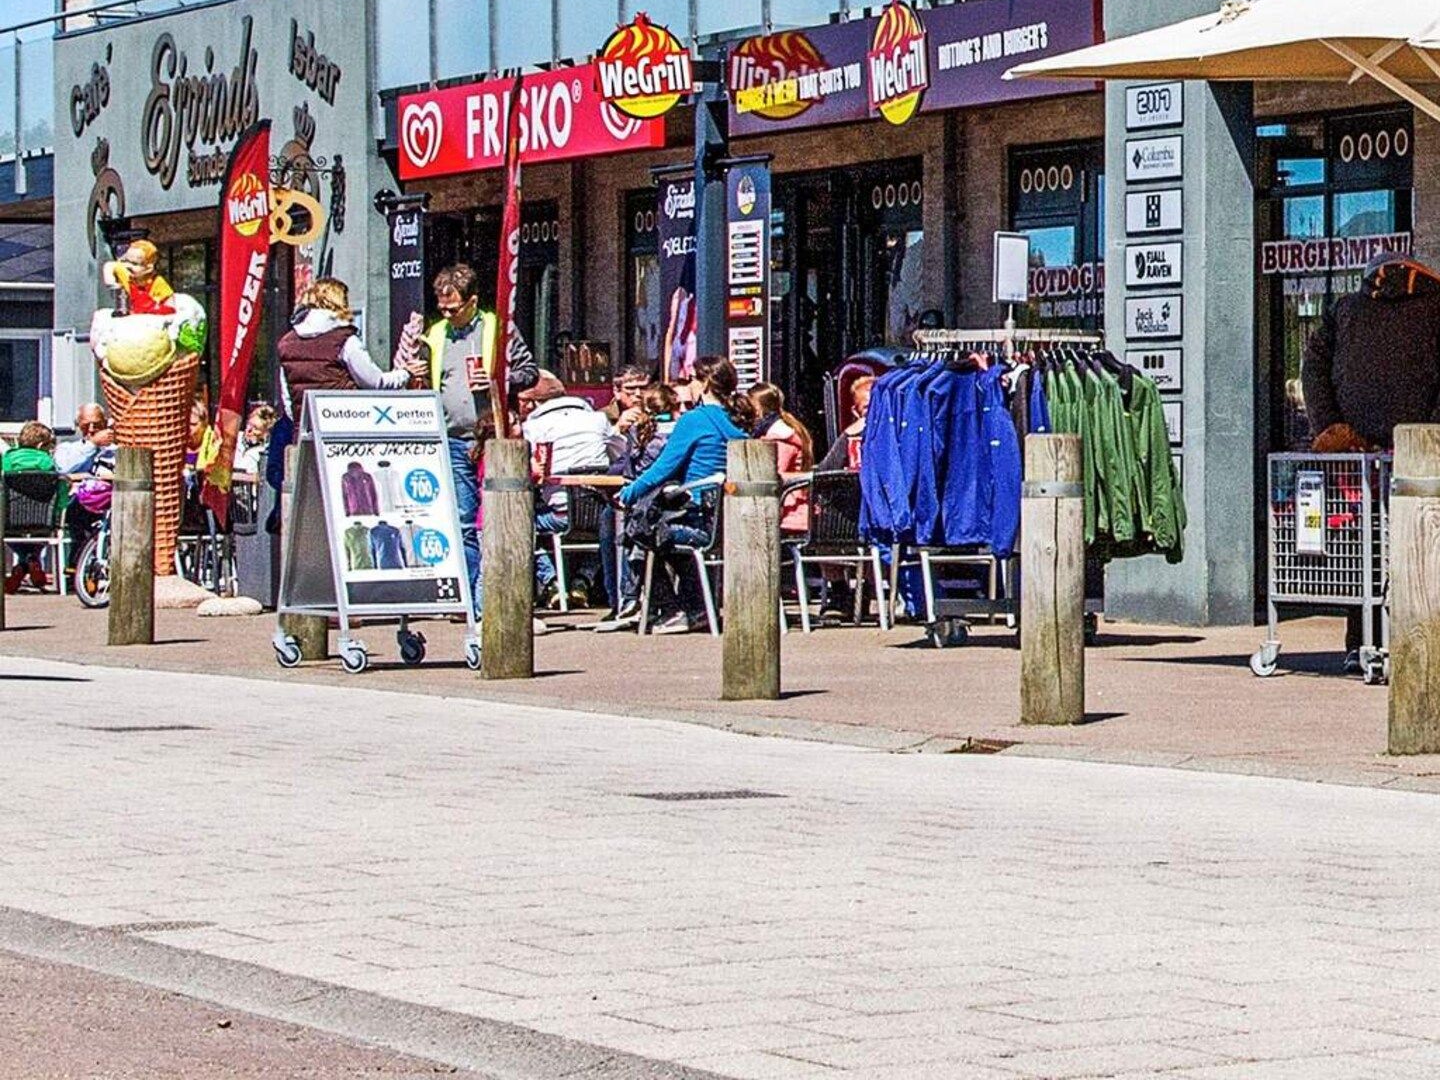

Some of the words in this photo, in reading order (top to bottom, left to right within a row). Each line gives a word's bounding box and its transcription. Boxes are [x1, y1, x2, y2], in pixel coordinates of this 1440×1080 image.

[982, 31, 1002, 61] AND
[598, 53, 692, 98] WeGrill
[843, 62, 861, 90] YOU
[869, 37, 928, 104] WeGrill
[466, 80, 573, 159] FRISKO
[1262, 237, 1347, 274] BURGER
[1135, 308, 1153, 321] Jack
[321, 408, 371, 419] Outdoor
[379, 442, 437, 457] JACKETS
